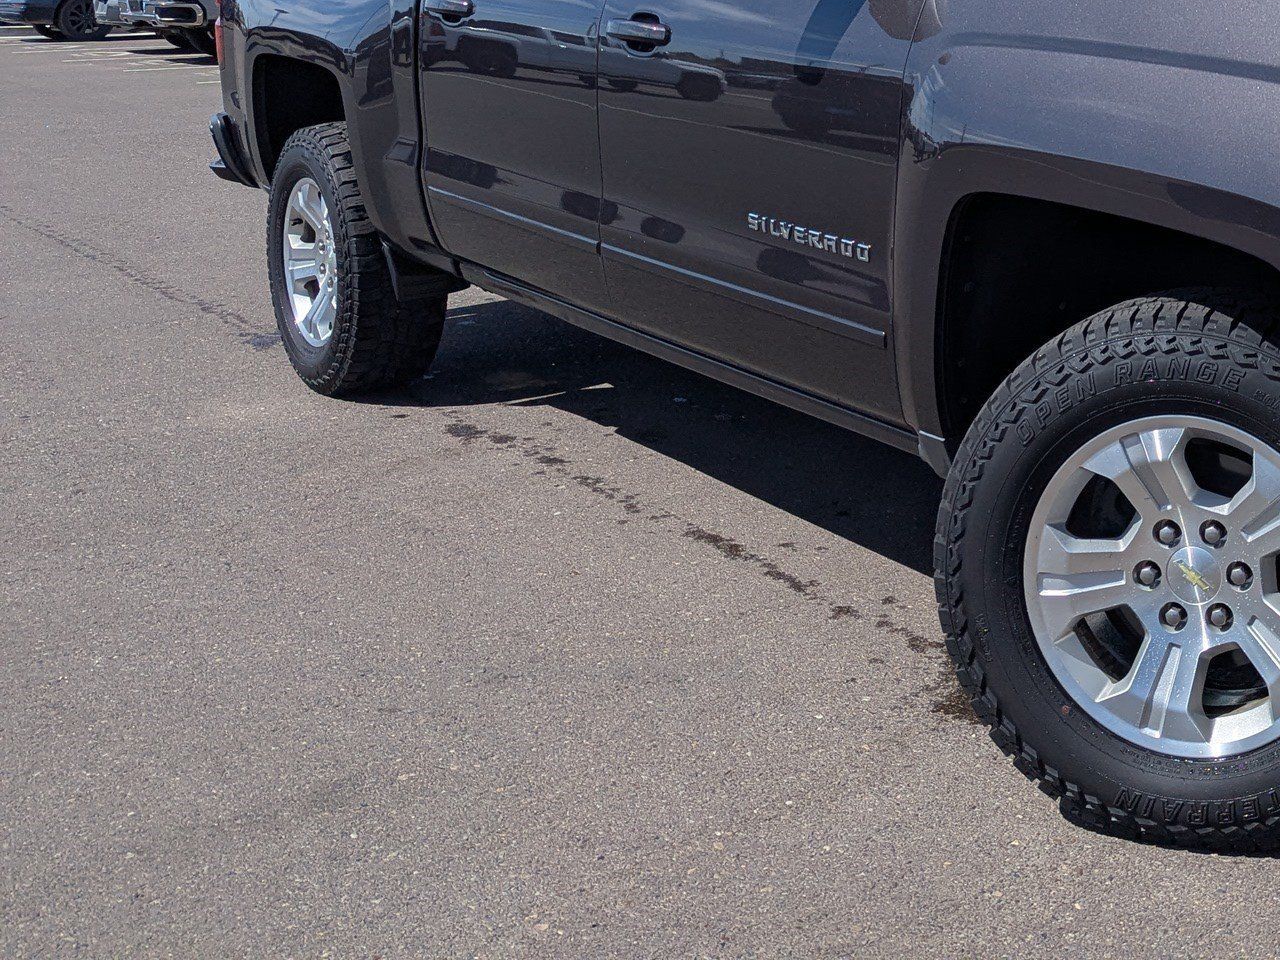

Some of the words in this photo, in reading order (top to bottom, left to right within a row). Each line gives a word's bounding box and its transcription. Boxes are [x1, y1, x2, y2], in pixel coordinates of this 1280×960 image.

[747, 212, 871, 263] SILVERADO
[1015, 370, 1098, 446] OPEN
[1113, 356, 1248, 392] RANGE
